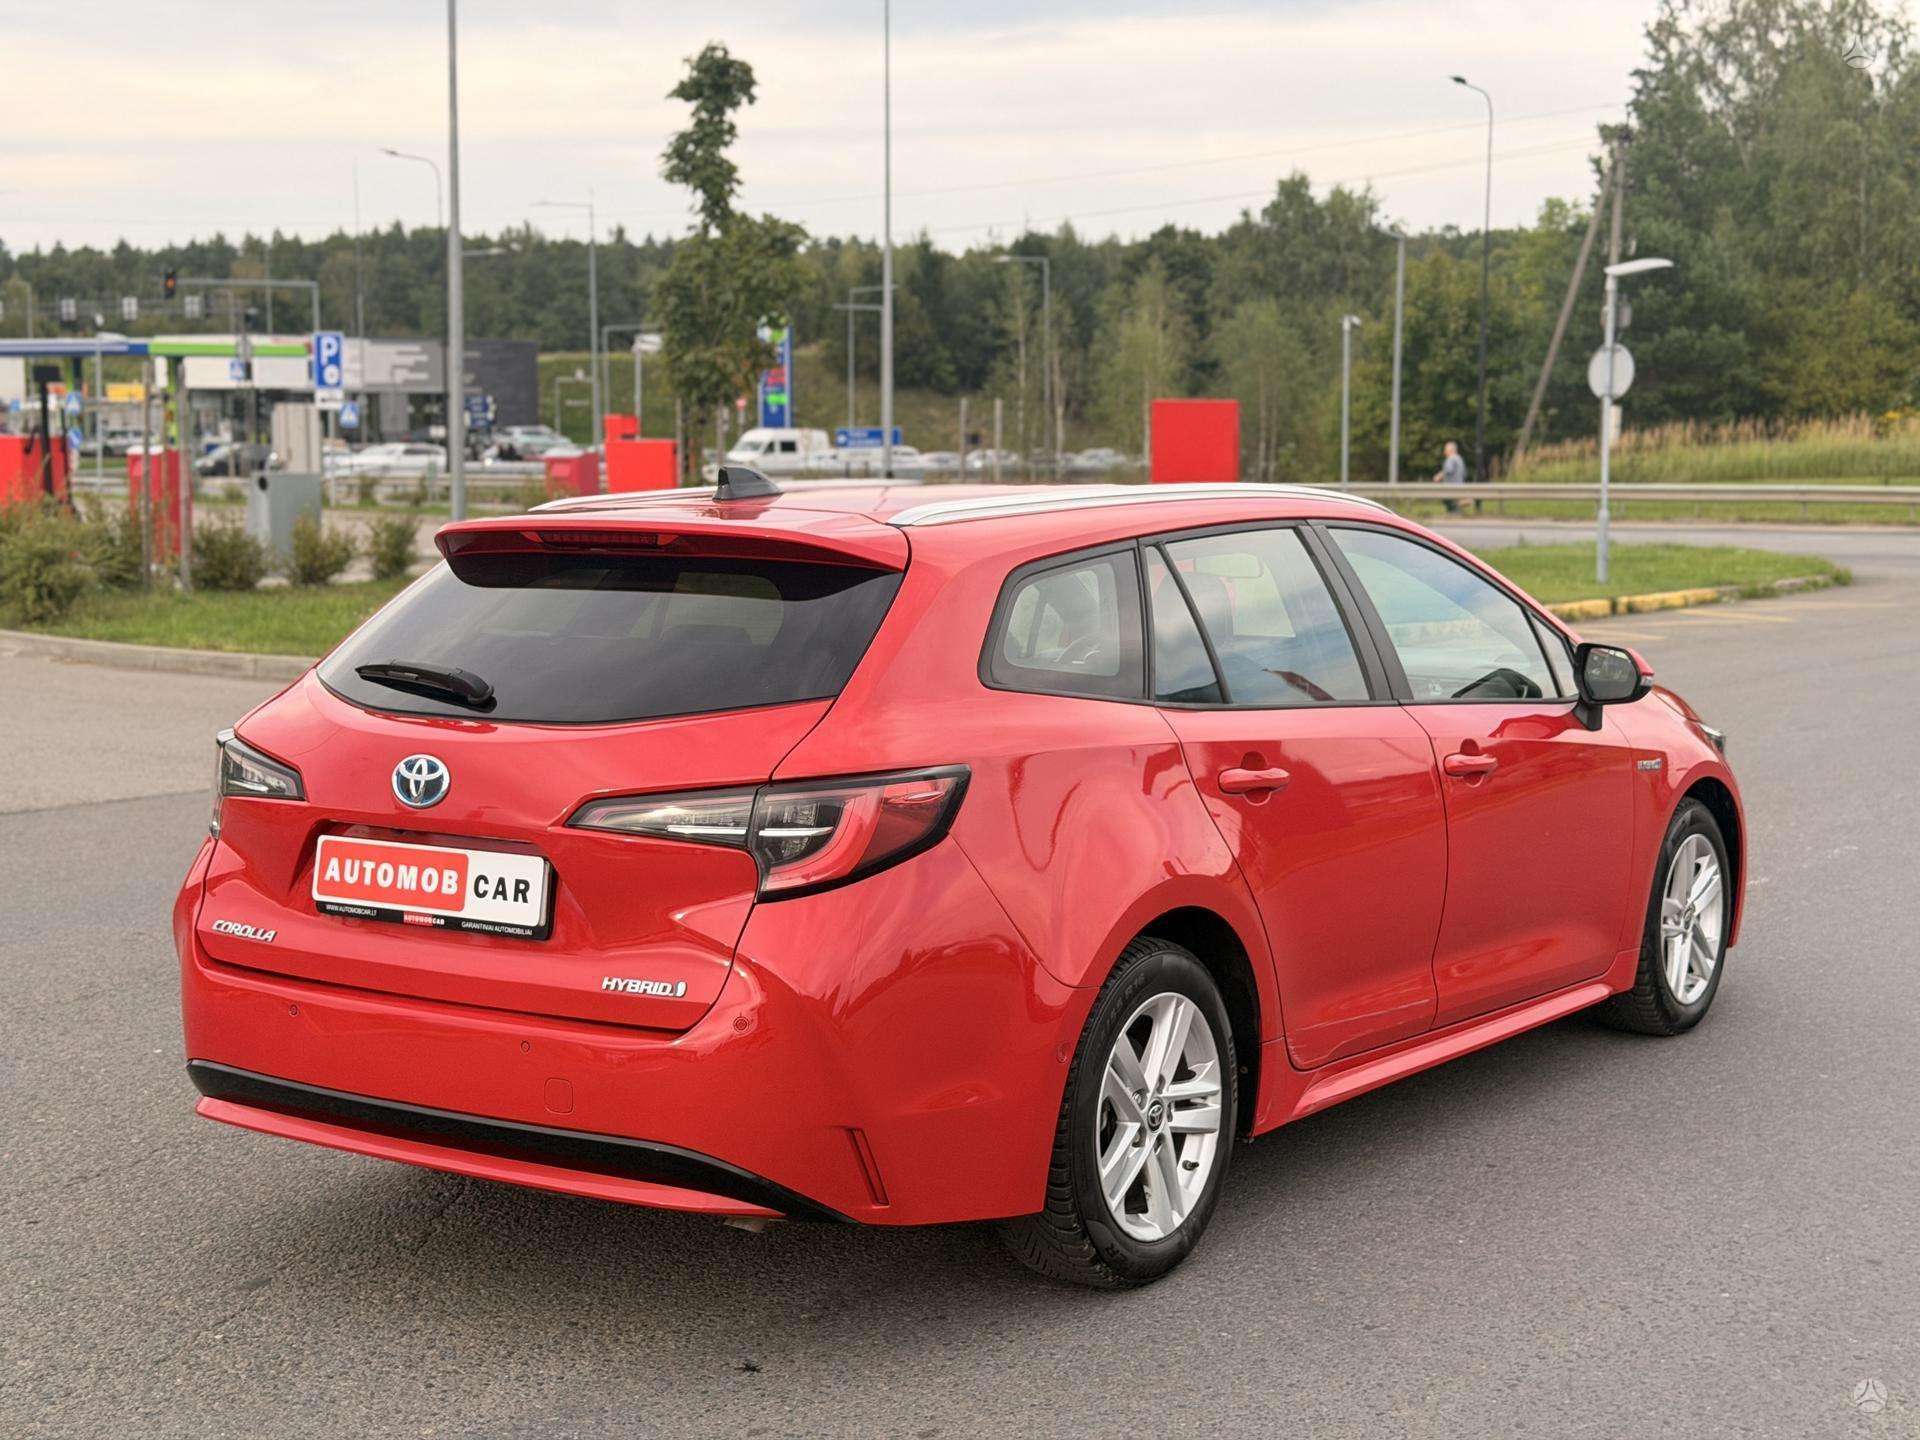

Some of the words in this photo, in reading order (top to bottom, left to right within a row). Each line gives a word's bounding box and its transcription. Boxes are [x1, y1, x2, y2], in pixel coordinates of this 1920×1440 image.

[321, 336, 339, 367] P
[324, 856, 459, 896] AUTOMOB
[473, 874, 531, 904] CAR
[212, 919, 277, 942] COROLLA
[602, 976, 673, 997] HYBRID
